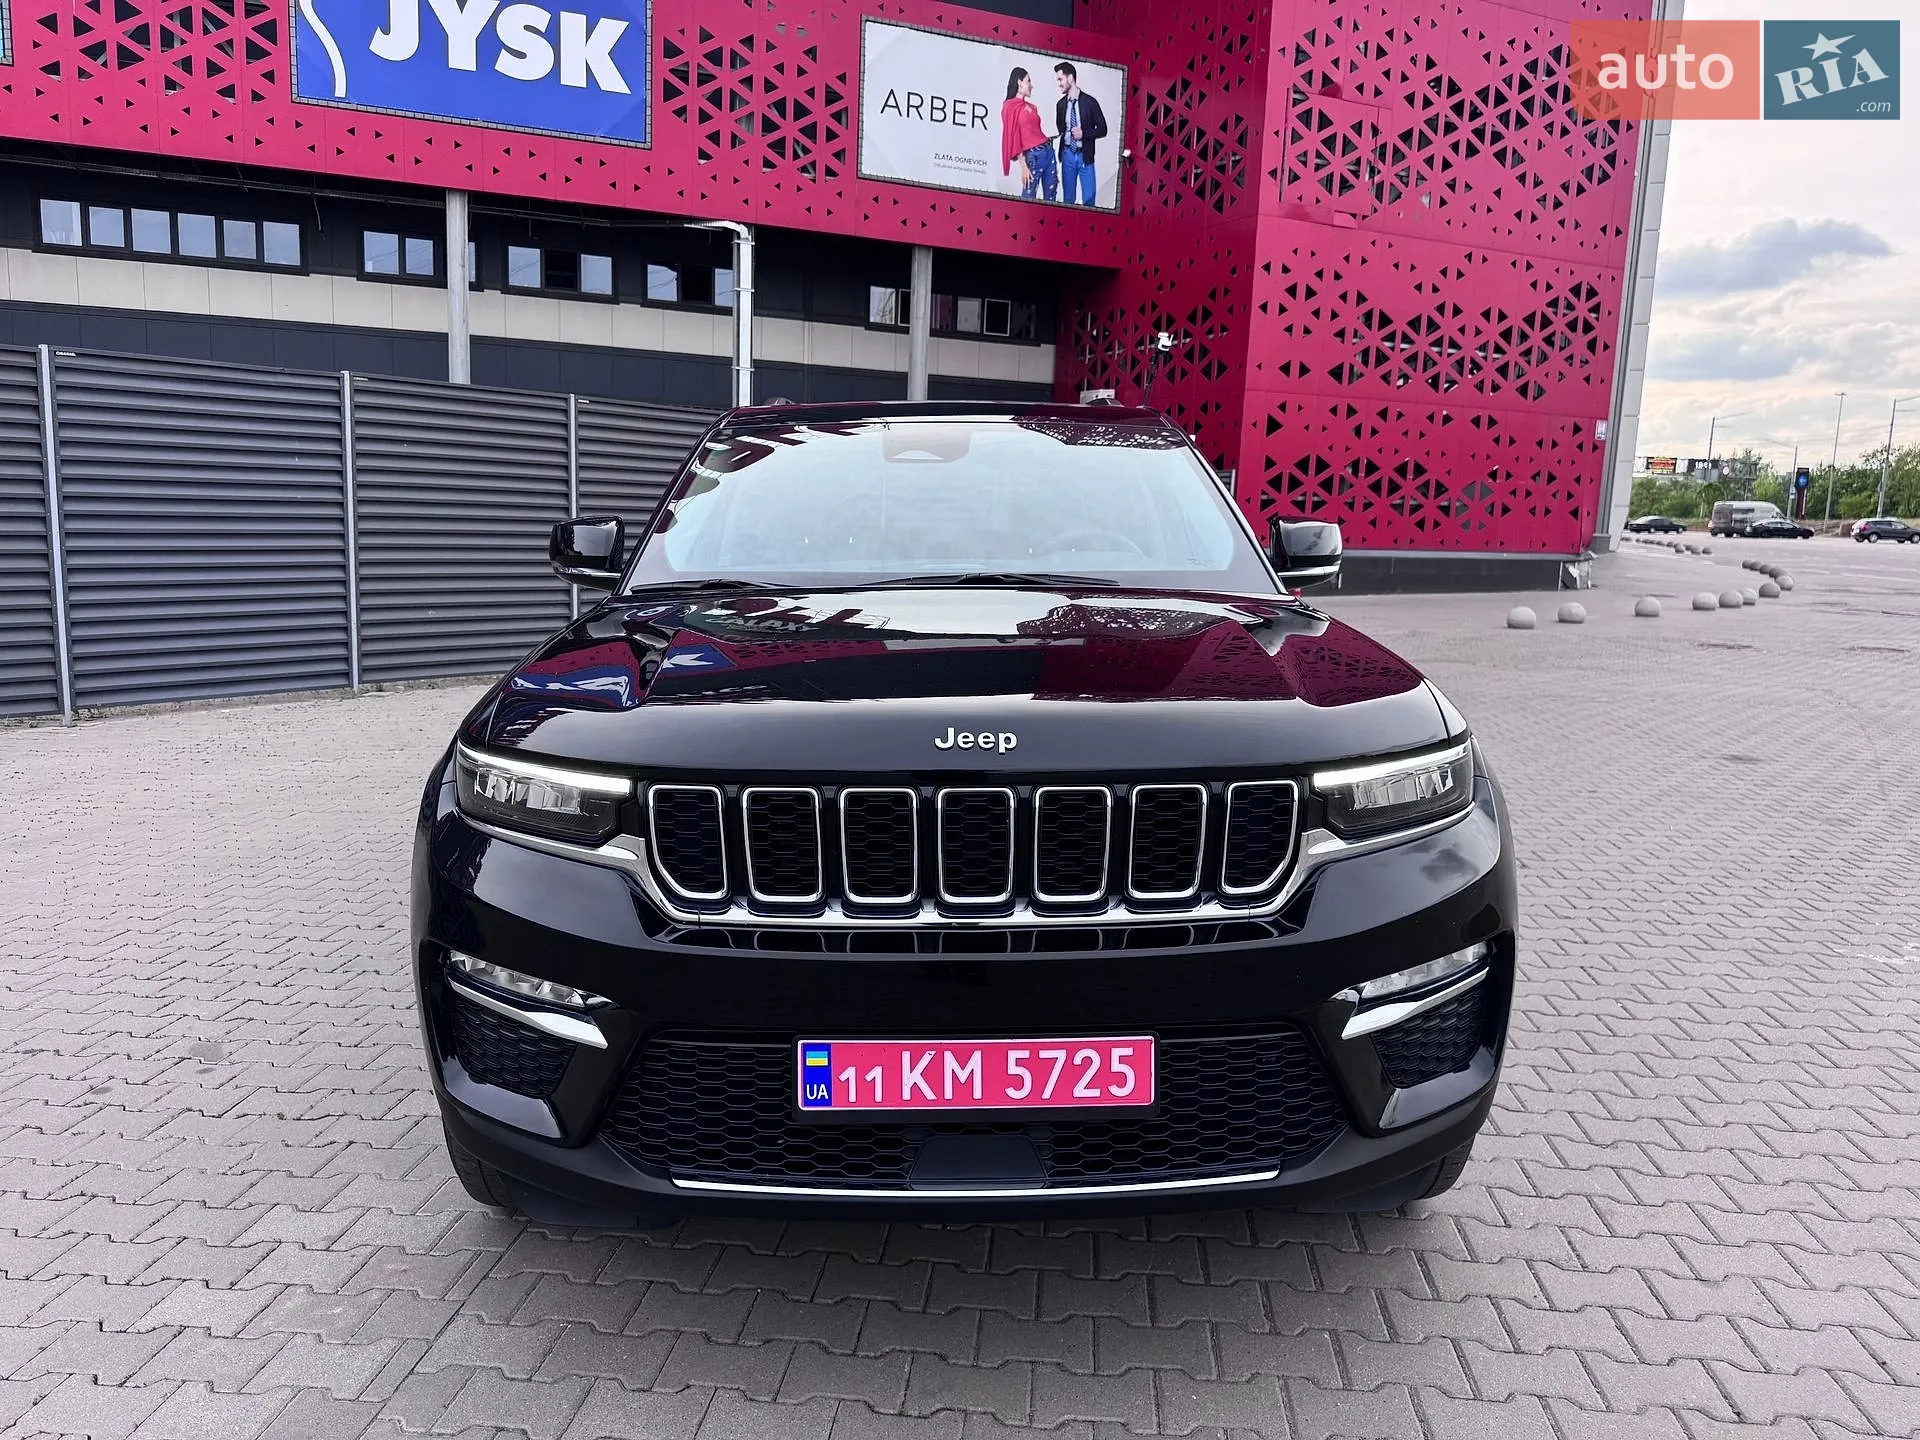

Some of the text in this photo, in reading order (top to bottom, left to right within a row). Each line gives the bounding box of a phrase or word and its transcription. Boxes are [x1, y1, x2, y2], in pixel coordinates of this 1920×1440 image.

[368, 0, 632, 95] JYSK
[880, 88, 989, 131] ARBER
[934, 153, 953, 161] ZLATA
[934, 727, 1018, 754] Jeep
[806, 1084, 829, 1100] UA
[838, 1047, 1136, 1103] 11 KM 5725
